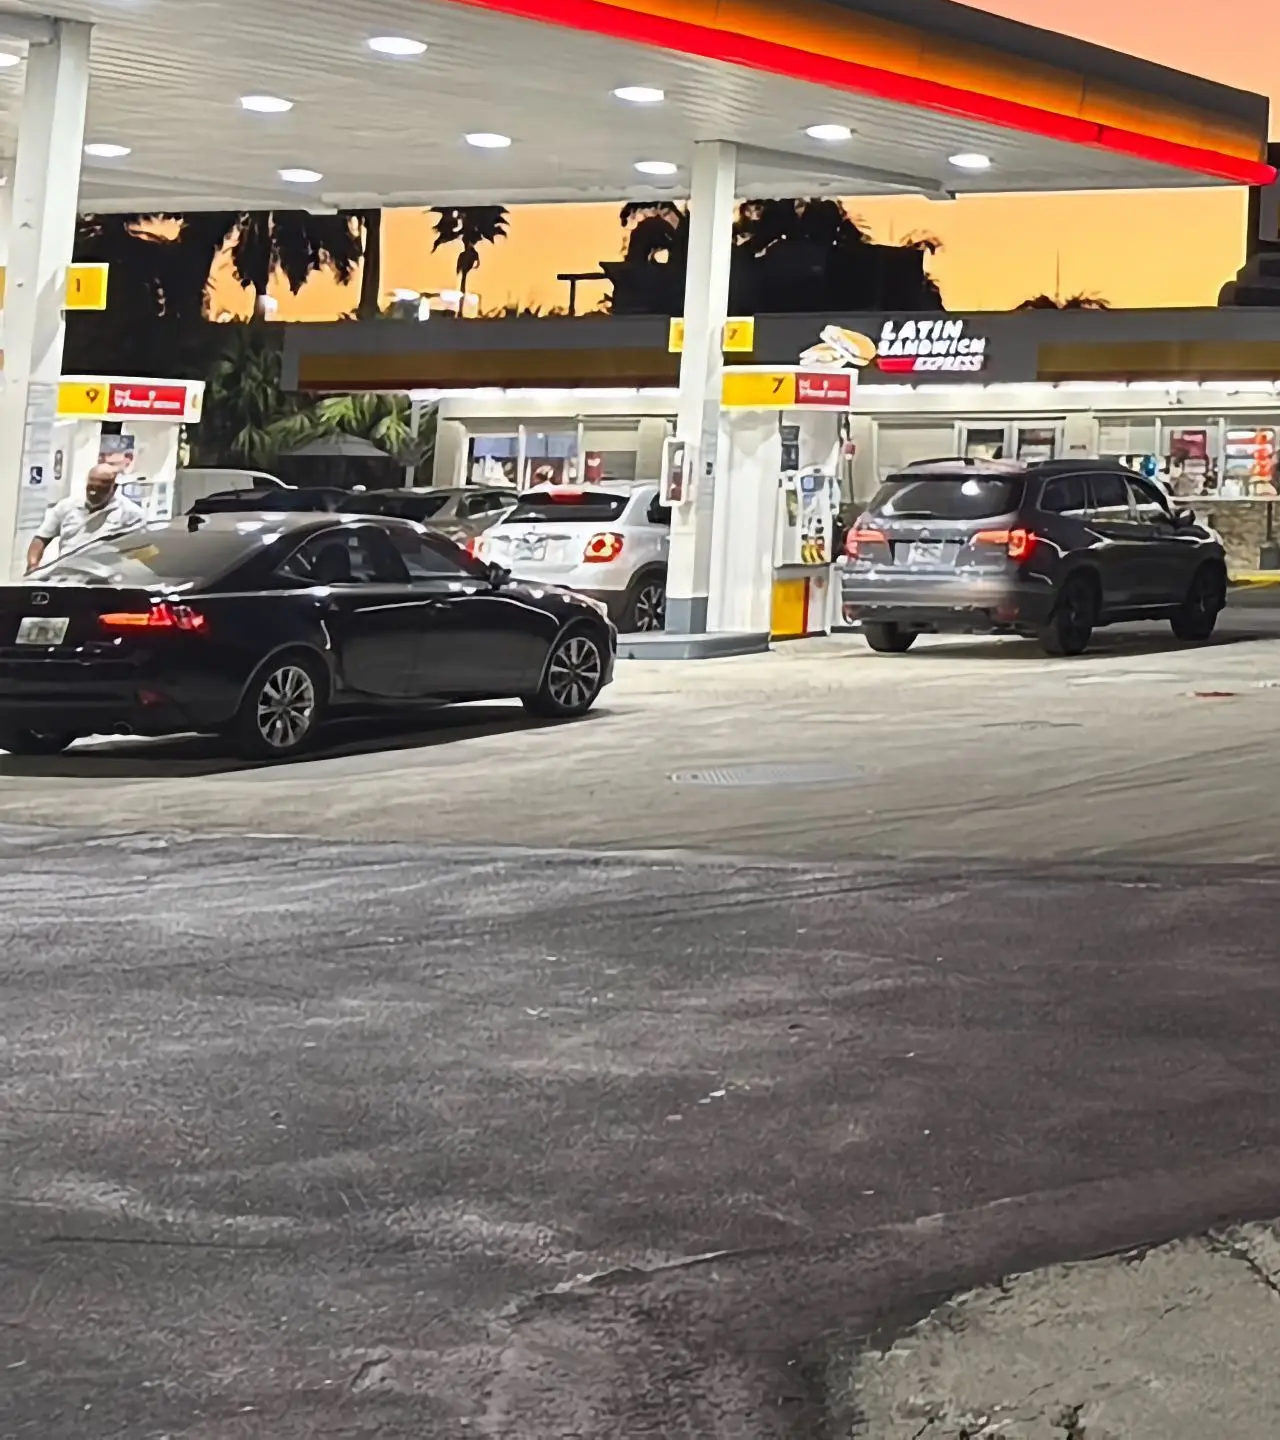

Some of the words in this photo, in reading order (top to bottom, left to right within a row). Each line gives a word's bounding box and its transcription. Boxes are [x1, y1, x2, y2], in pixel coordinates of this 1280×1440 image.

[881, 320, 963, 340] LATIN
[878, 337, 986, 356] SANDWICH
[772, 376, 786, 394] 7
